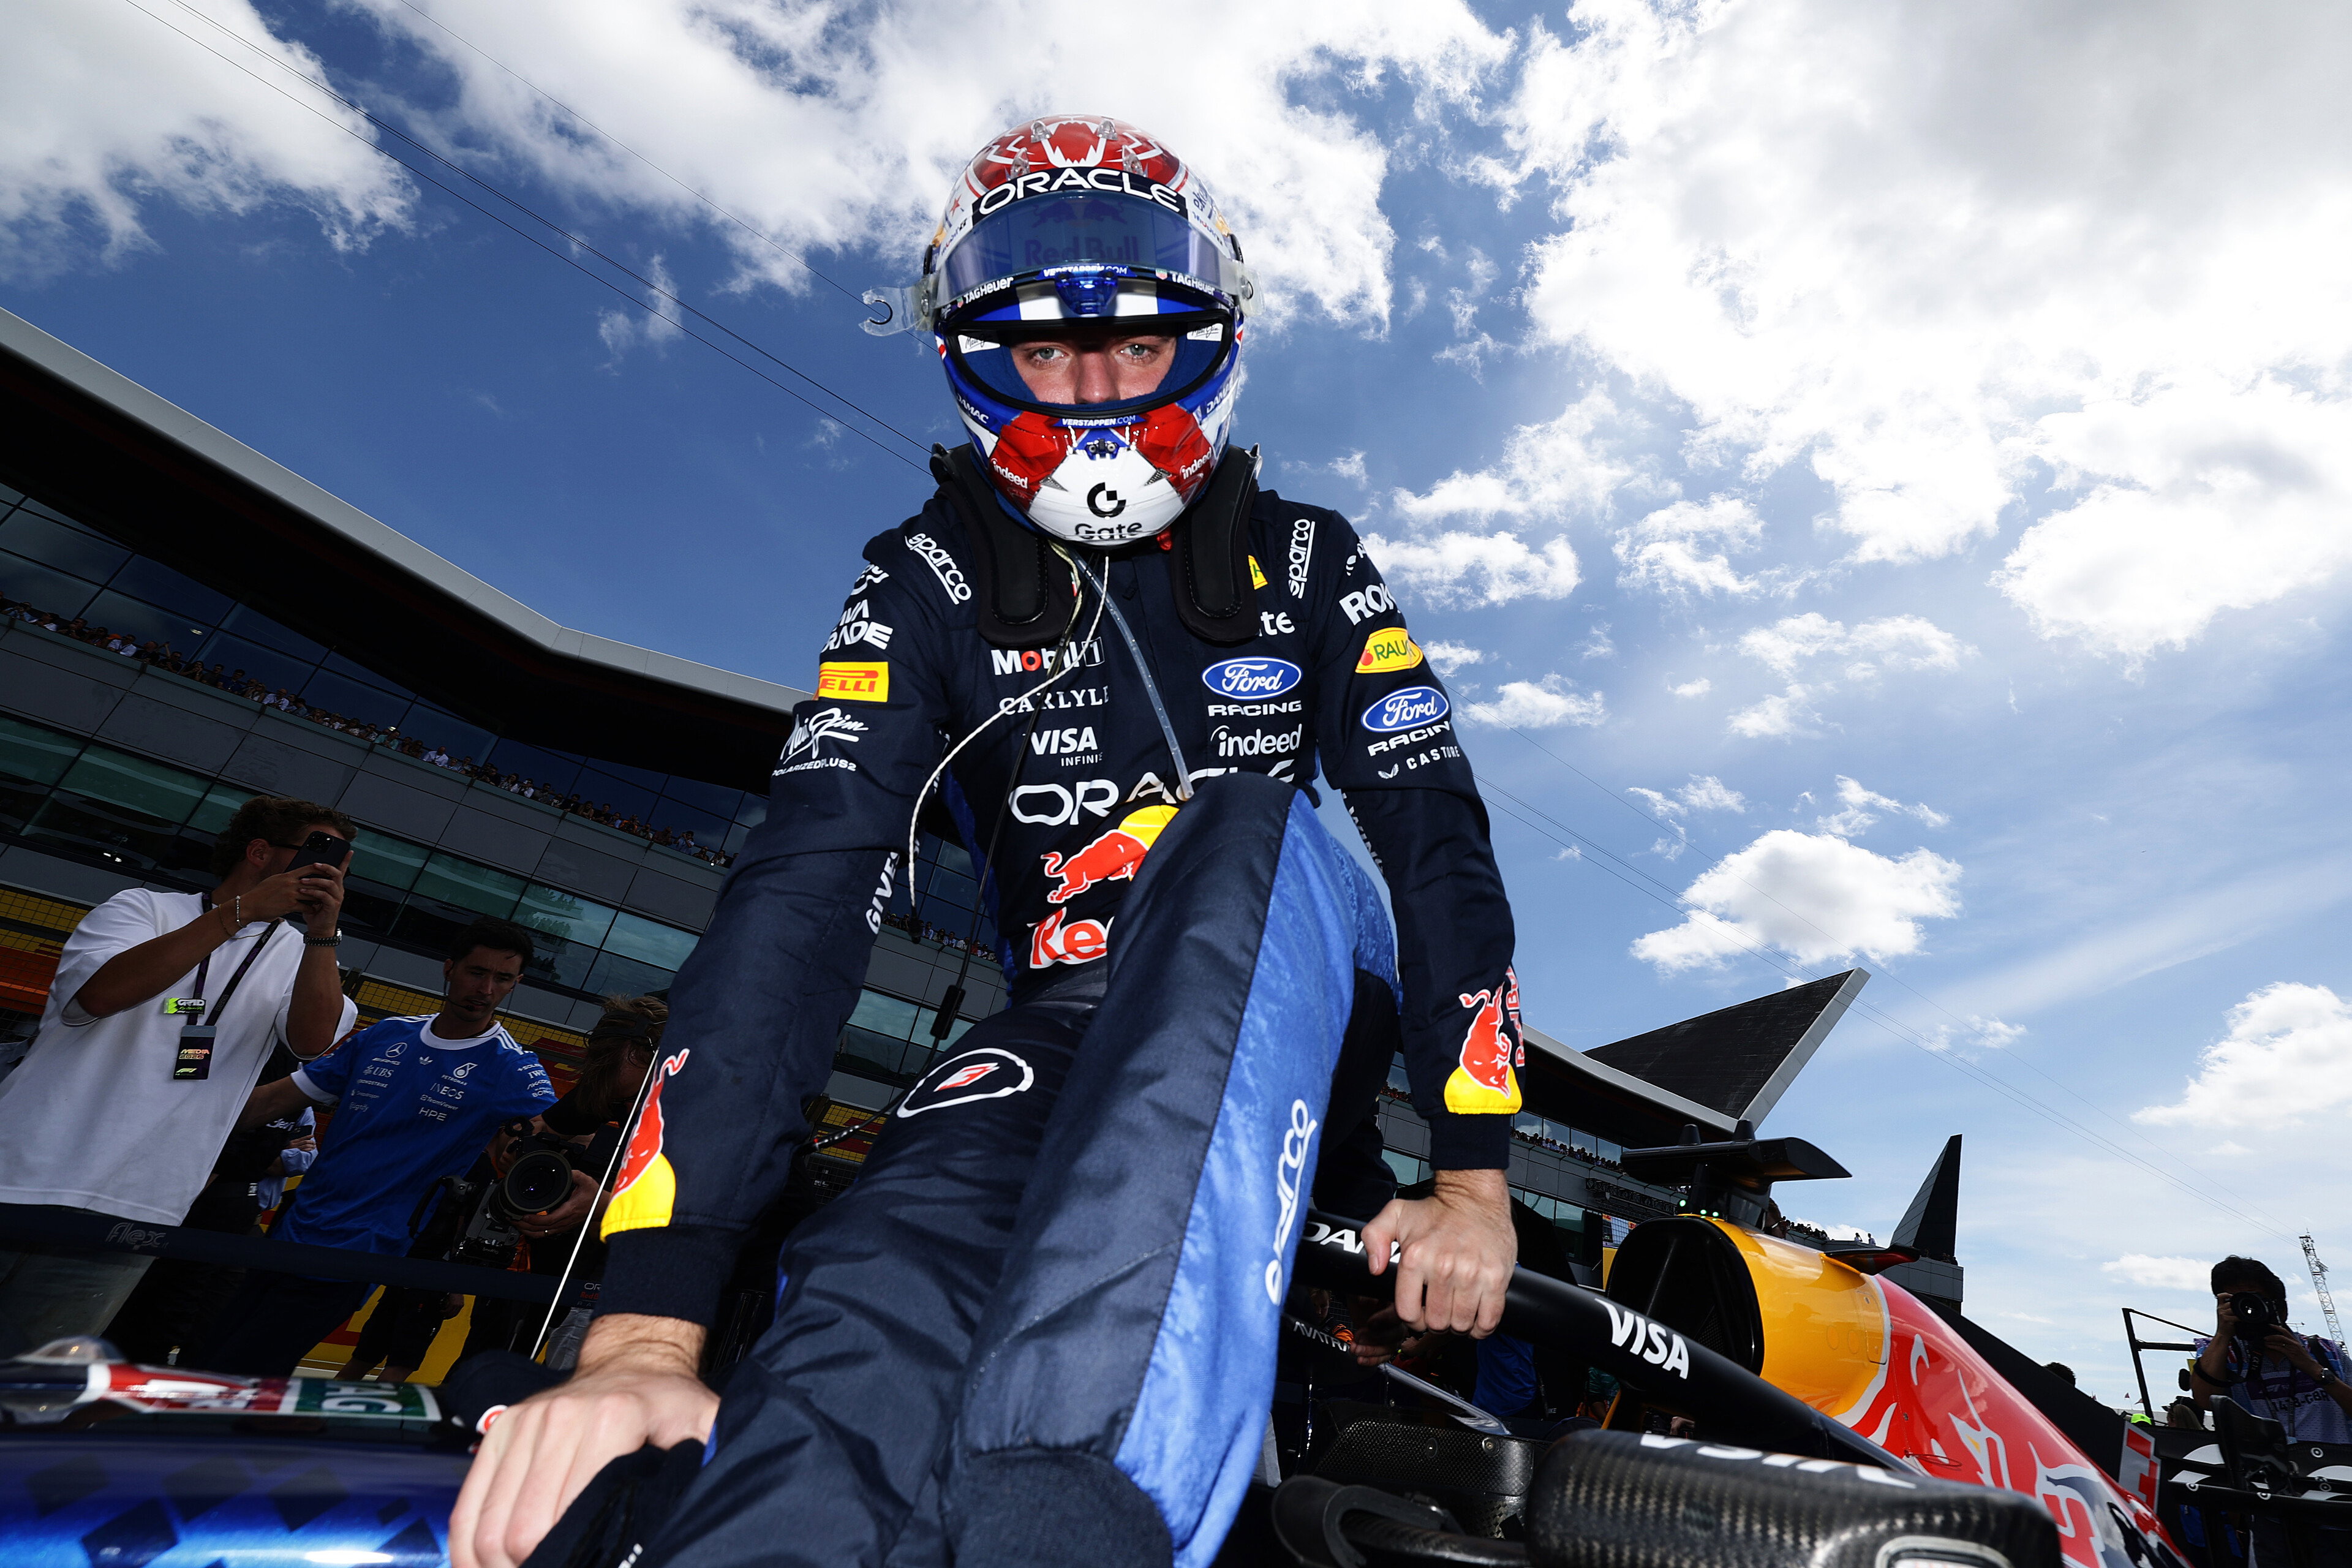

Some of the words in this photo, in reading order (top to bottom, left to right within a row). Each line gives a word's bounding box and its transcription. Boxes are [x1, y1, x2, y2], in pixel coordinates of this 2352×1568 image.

[979, 167, 1181, 216] ORACLE
[957, 393, 989, 424] DAMAC
[1061, 415, 1136, 427] VERSTAPPEN.COM
[990, 458, 1028, 489] indeed
[1180, 447, 1212, 480] indeed
[1075, 522, 1142, 540] Gate
[905, 533, 972, 605] sparco
[1289, 519, 1316, 598] sparco
[1339, 582, 1401, 625] ROK
[990, 641, 1080, 676] Mobil
[1090, 641, 1101, 664] 1
[819, 669, 880, 693] ELLI
[1223, 663, 1285, 692] Ford
[999, 685, 1109, 715] CARLYLE
[1207, 700, 1302, 717] RACING
[1382, 692, 1438, 727] Ford
[1025, 726, 1099, 756] VISA
[1210, 723, 1303, 758] indeed
[1367, 720, 1450, 757] RACIN
[1027, 906, 1115, 969] Re
[372, 1067, 394, 1078] UBS
[440, 1074, 468, 1086] PETRONAS
[527, 1069, 546, 1079] IWC
[429, 1082, 464, 1099] INEOS
[418, 1107, 448, 1121] HPE
[1594, 1297, 1689, 1380] VISA
